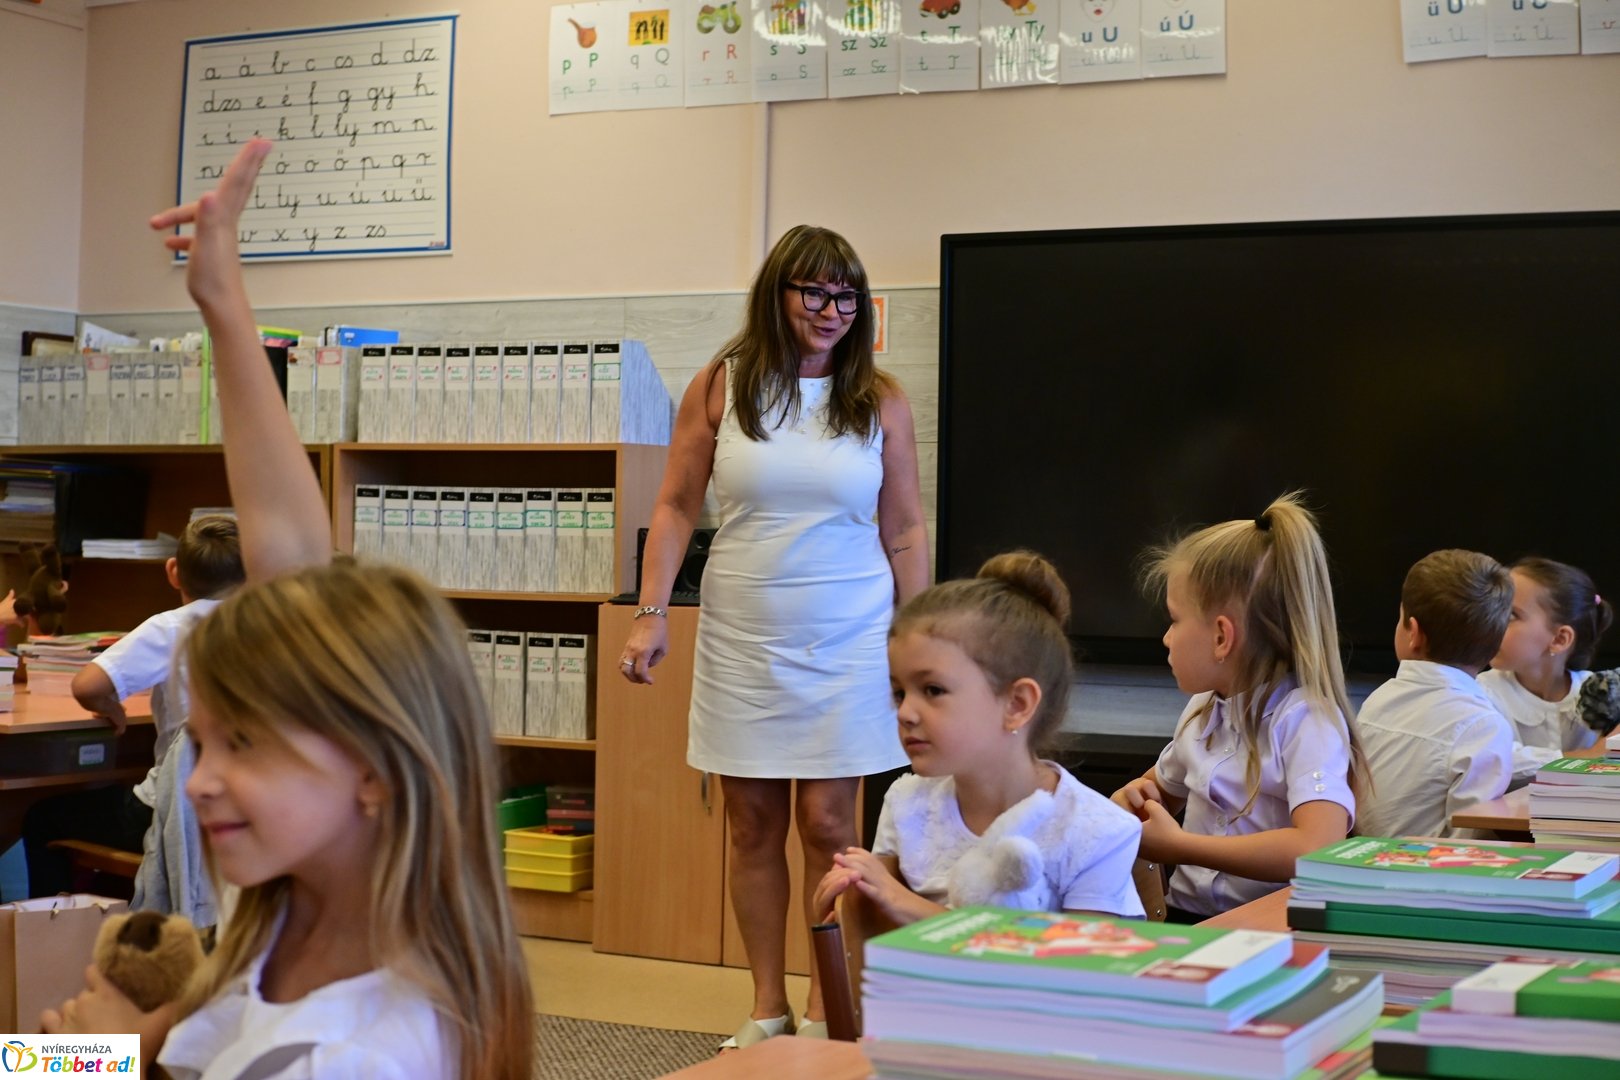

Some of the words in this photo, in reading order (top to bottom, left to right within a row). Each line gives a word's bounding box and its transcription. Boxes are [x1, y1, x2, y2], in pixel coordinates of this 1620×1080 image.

[1428, 1, 1439, 16] ü
[1160, 16, 1171, 32] ú
[1179, 10, 1194, 30] Ú
[1082, 32, 1092, 42] u
[1103, 26, 1118, 42] U
[204, 67, 222, 80] a
[239, 56, 256, 78] á
[271, 50, 290, 75] b
[305, 58, 317, 72] c
[371, 41, 388, 66] d
[403, 38, 436, 63] dz
[589, 52, 599, 68] P
[630, 54, 640, 70] q
[655, 47, 670, 66] Q
[702, 50, 711, 62] r
[727, 43, 737, 60] R
[770, 45, 778, 56] s
[203, 90, 242, 113] dzs
[255, 96, 267, 109] e
[281, 85, 292, 107] é
[309, 81, 319, 116] f
[338, 89, 352, 113] g
[367, 86, 396, 111] gy
[414, 72, 435, 97] h
[278, 116, 295, 140] k
[311, 114, 324, 138] l
[335, 113, 359, 147] ly
[373, 120, 402, 134] m
[413, 118, 434, 131] n
[275, 153, 290, 175] ó
[334, 149, 349, 171] ő
[361, 156, 380, 180] p
[392, 154, 407, 178] q
[255, 185, 266, 209] t
[278, 184, 300, 218] ty
[316, 193, 338, 206] u
[349, 181, 370, 204] ú
[411, 178, 432, 201] ű
[271, 228, 290, 242] x
[303, 227, 319, 252] y
[334, 226, 347, 239] z
[365, 224, 387, 238] zs
